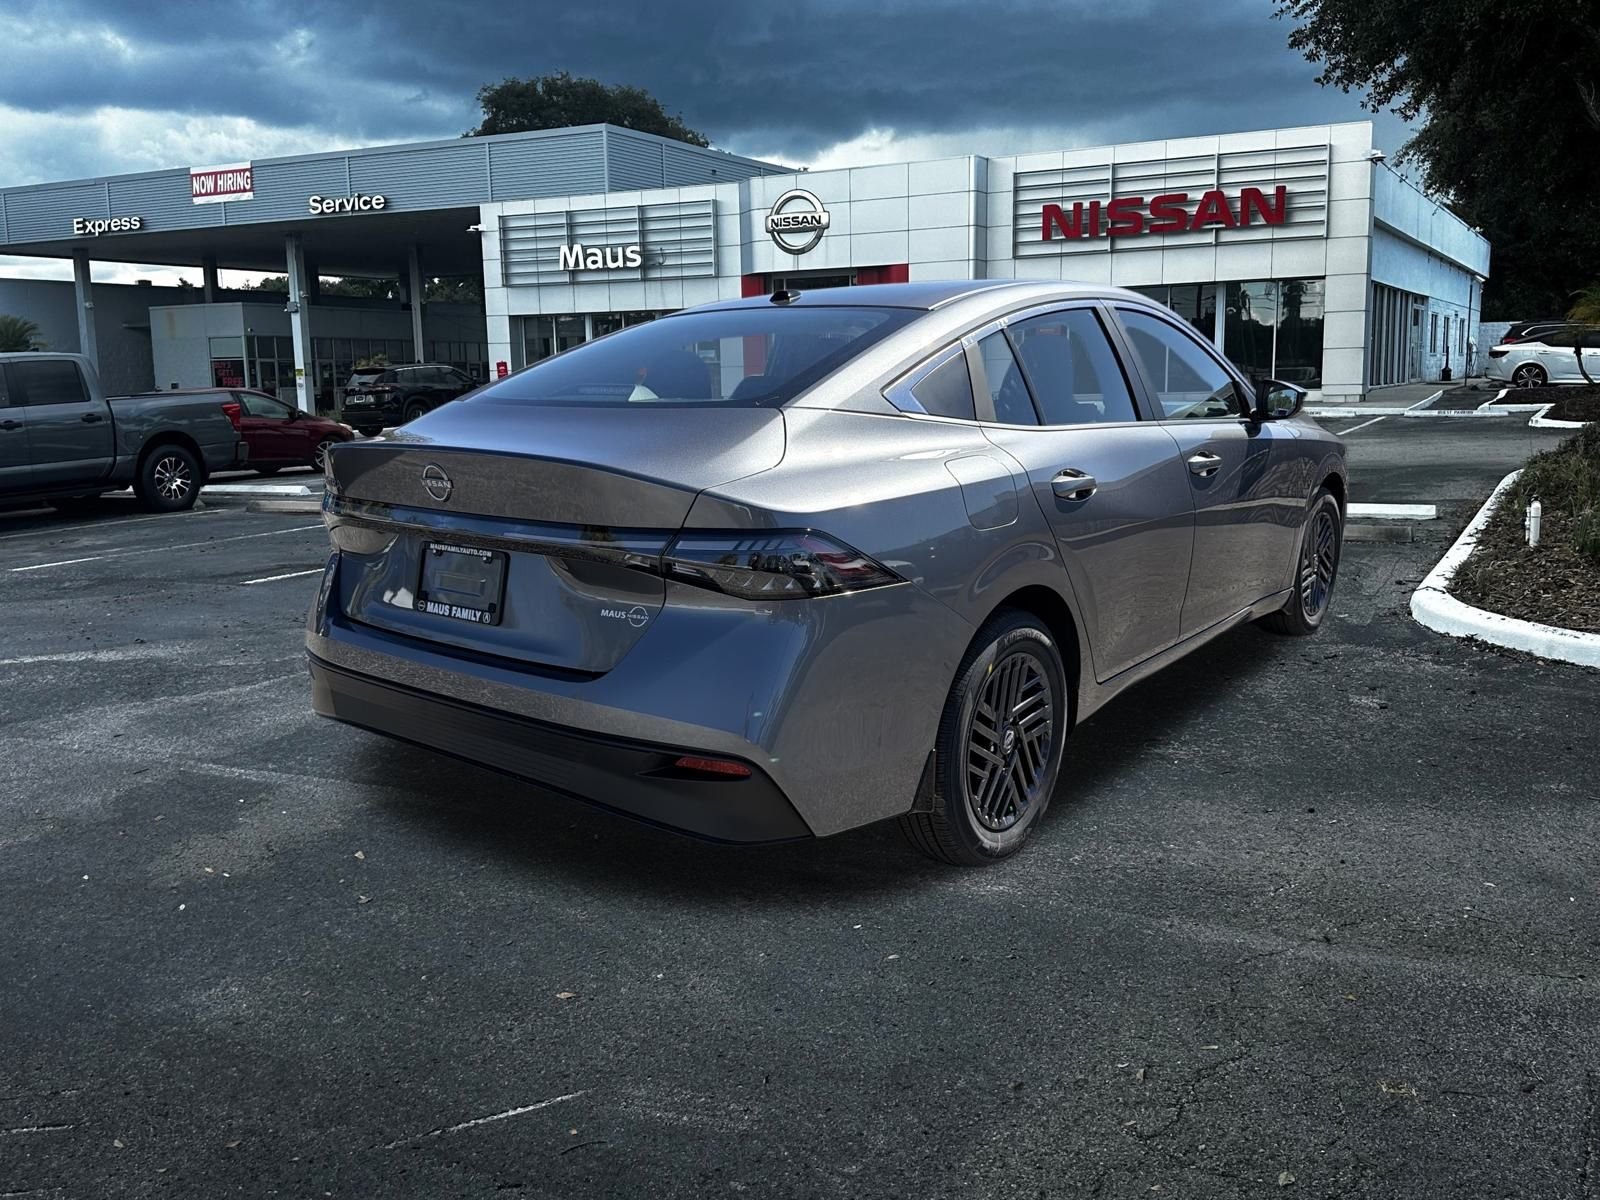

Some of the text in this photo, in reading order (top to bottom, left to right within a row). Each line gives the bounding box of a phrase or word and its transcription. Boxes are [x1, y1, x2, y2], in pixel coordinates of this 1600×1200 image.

[192, 171, 251, 194] NOW HIRING
[309, 193, 386, 214] Service
[1042, 185, 1287, 241] NISSAN
[73, 216, 142, 236] Express
[770, 215, 822, 228] NISSAN
[560, 243, 643, 270] Maus
[430, 543, 492, 557] MAUSFAMILYAUTO.COM
[426, 602, 482, 622] MAUS FAMILY
[601, 609, 627, 619] MAUS
